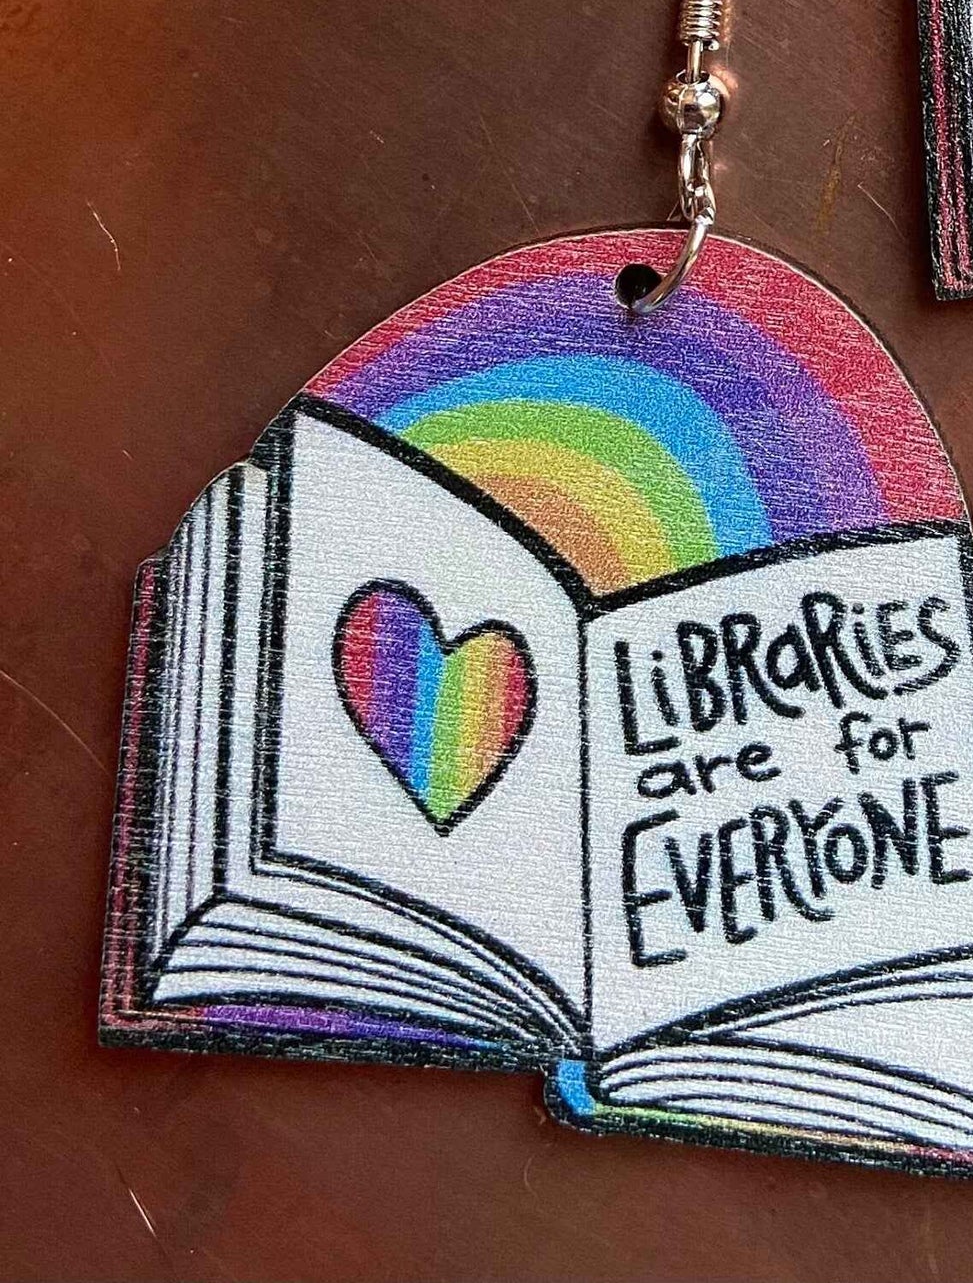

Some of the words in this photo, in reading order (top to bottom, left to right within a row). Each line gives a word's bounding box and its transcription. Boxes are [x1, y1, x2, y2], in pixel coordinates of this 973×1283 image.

[636, 740, 782, 799] are
[834, 711, 930, 775] for
[622, 770, 973, 967] EVERYONE
